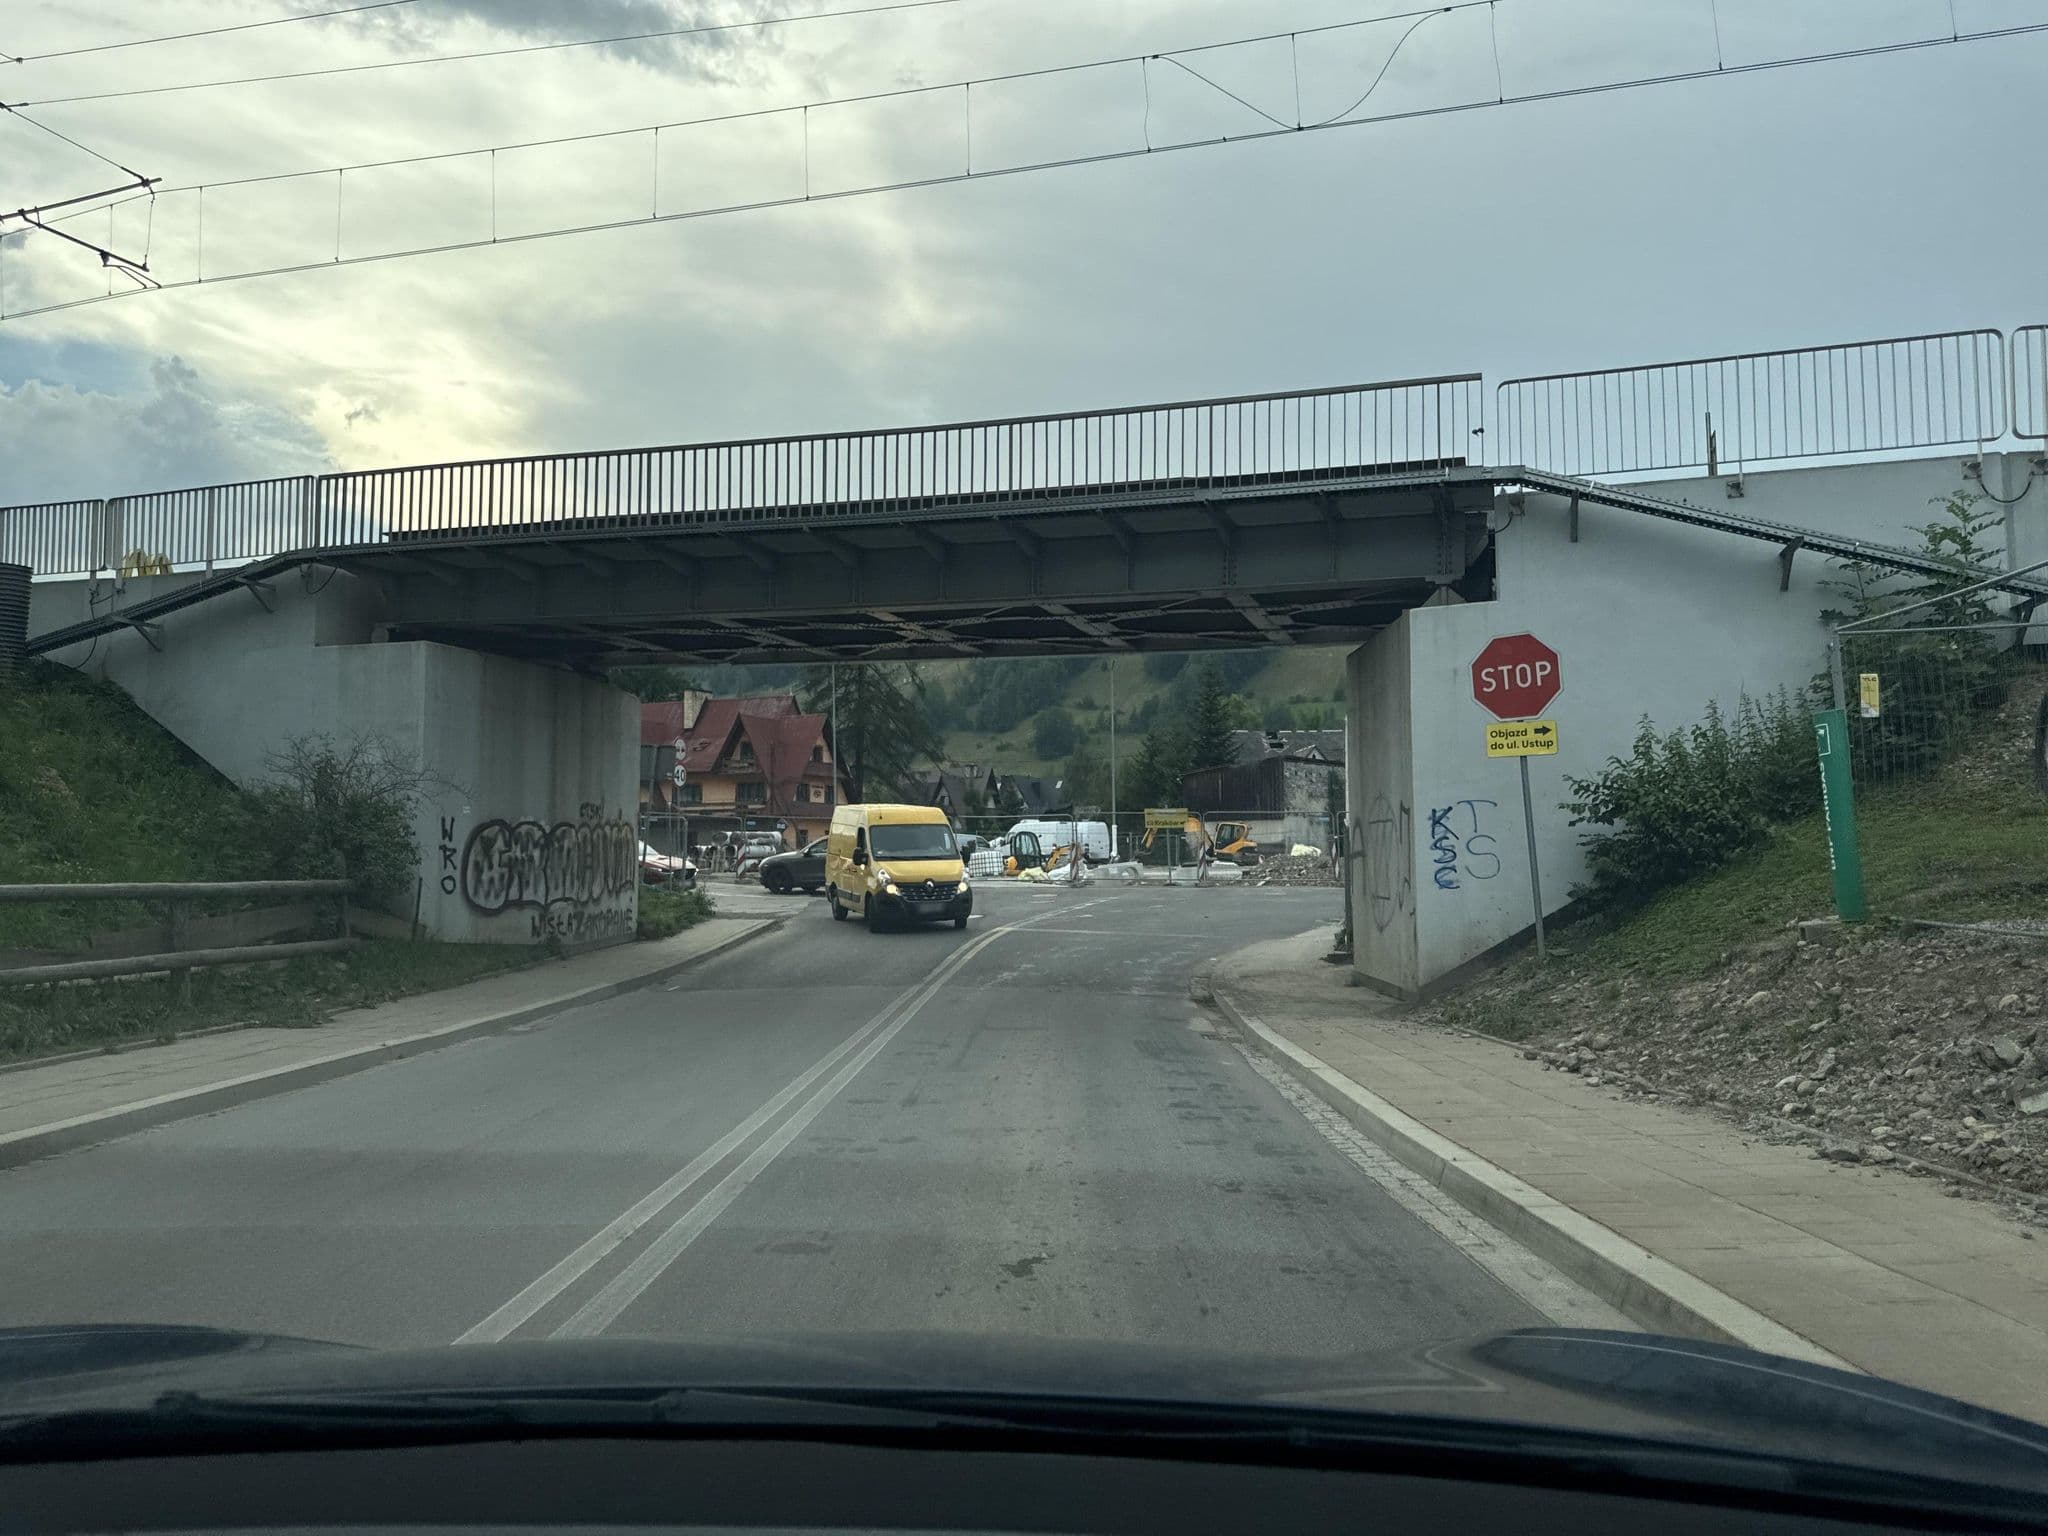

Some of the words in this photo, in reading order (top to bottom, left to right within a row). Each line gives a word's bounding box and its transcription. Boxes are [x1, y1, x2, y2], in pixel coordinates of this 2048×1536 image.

[1481, 661, 1552, 693] STOP
[1490, 728, 1528, 740] Objazd
[1490, 741, 1505, 750] do
[1507, 740, 1520, 750] ul.
[1522, 739, 1554, 750] Ustup
[674, 769, 686, 782] 40
